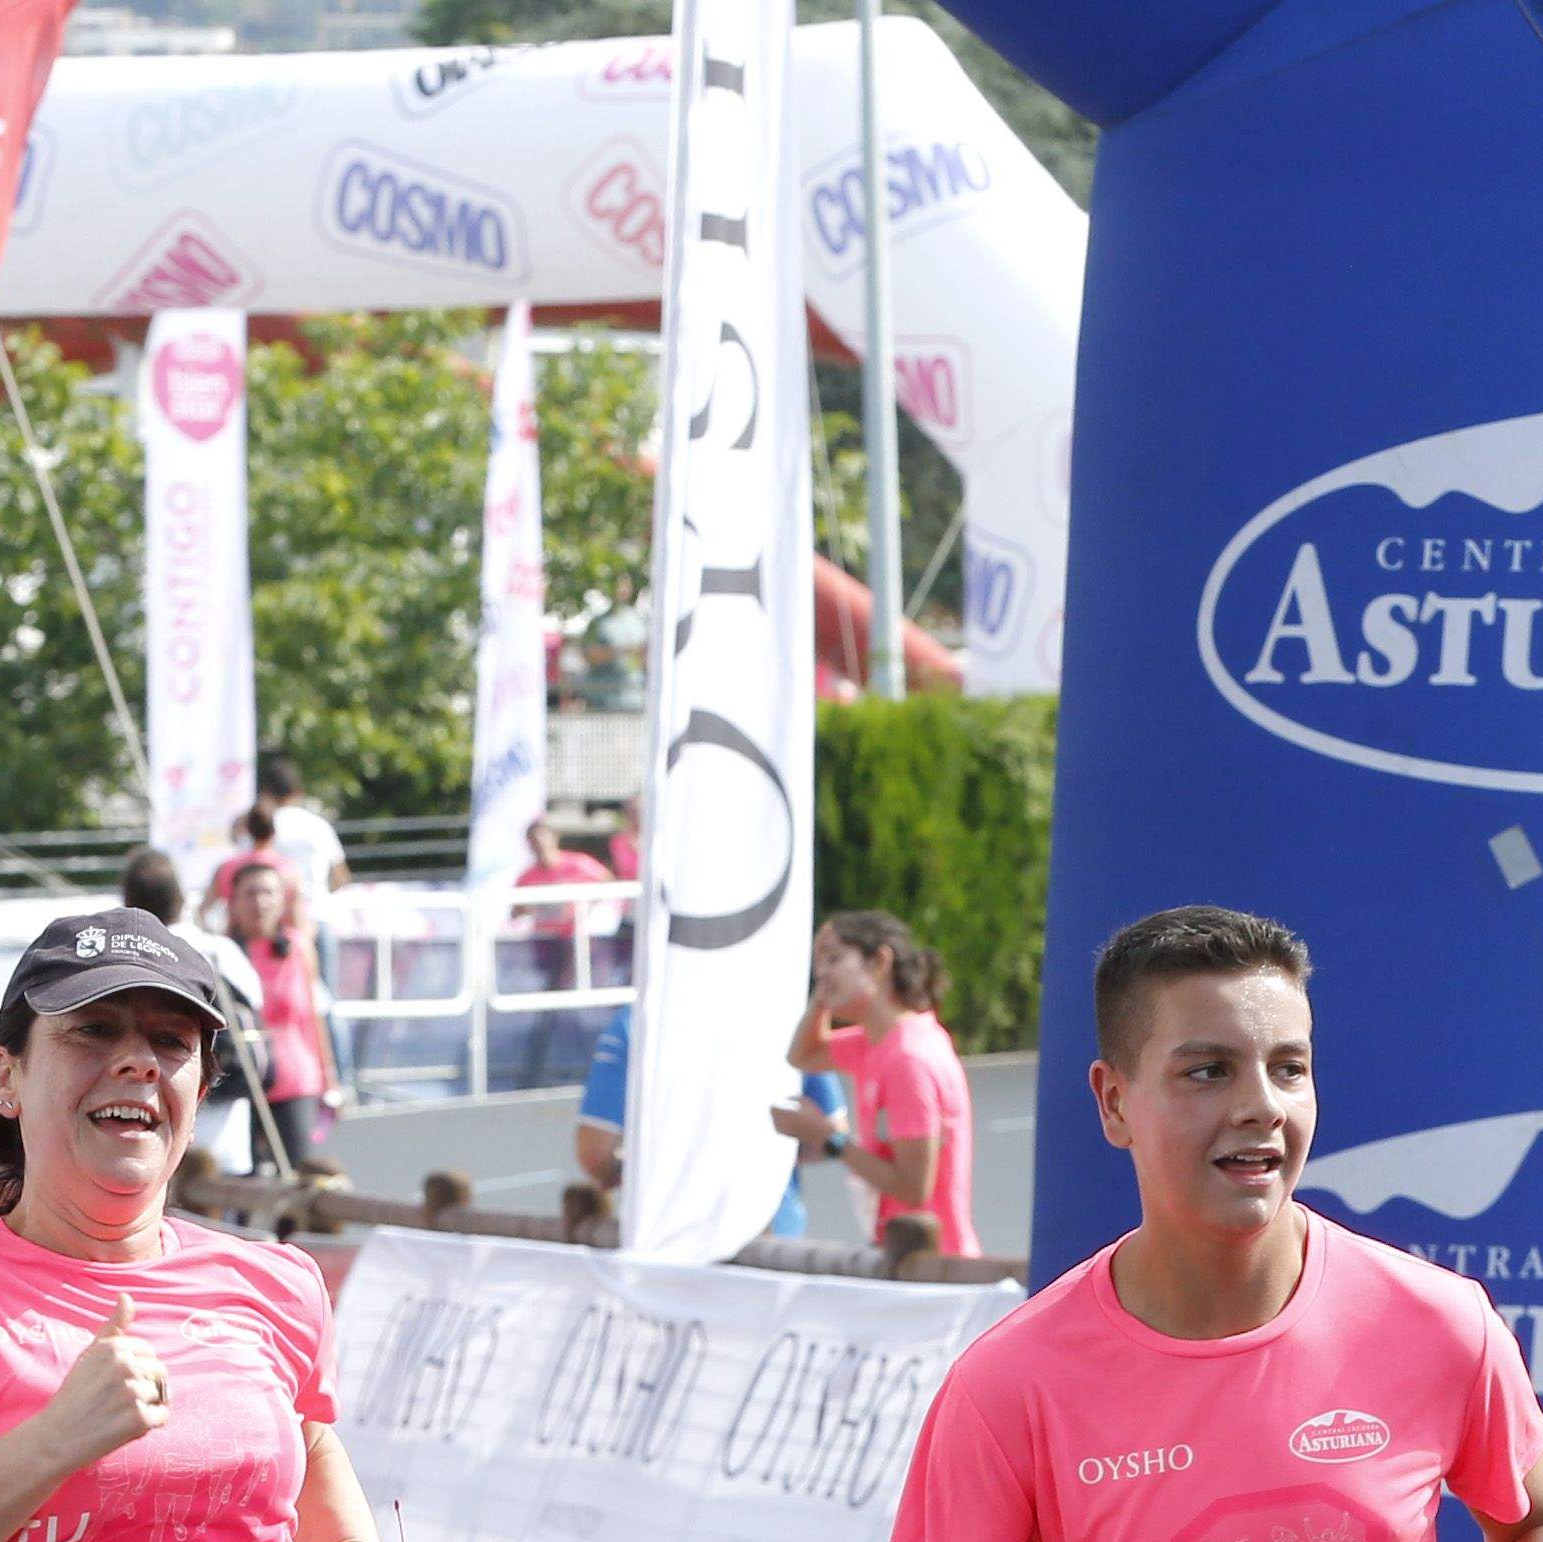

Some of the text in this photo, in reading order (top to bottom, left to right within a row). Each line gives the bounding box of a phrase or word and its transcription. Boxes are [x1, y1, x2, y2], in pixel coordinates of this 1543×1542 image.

[340, 160, 506, 270] COSMO
[1298, 1431, 1384, 1454] ASTURIANA
[1078, 1443, 1194, 1485] OYSHO
